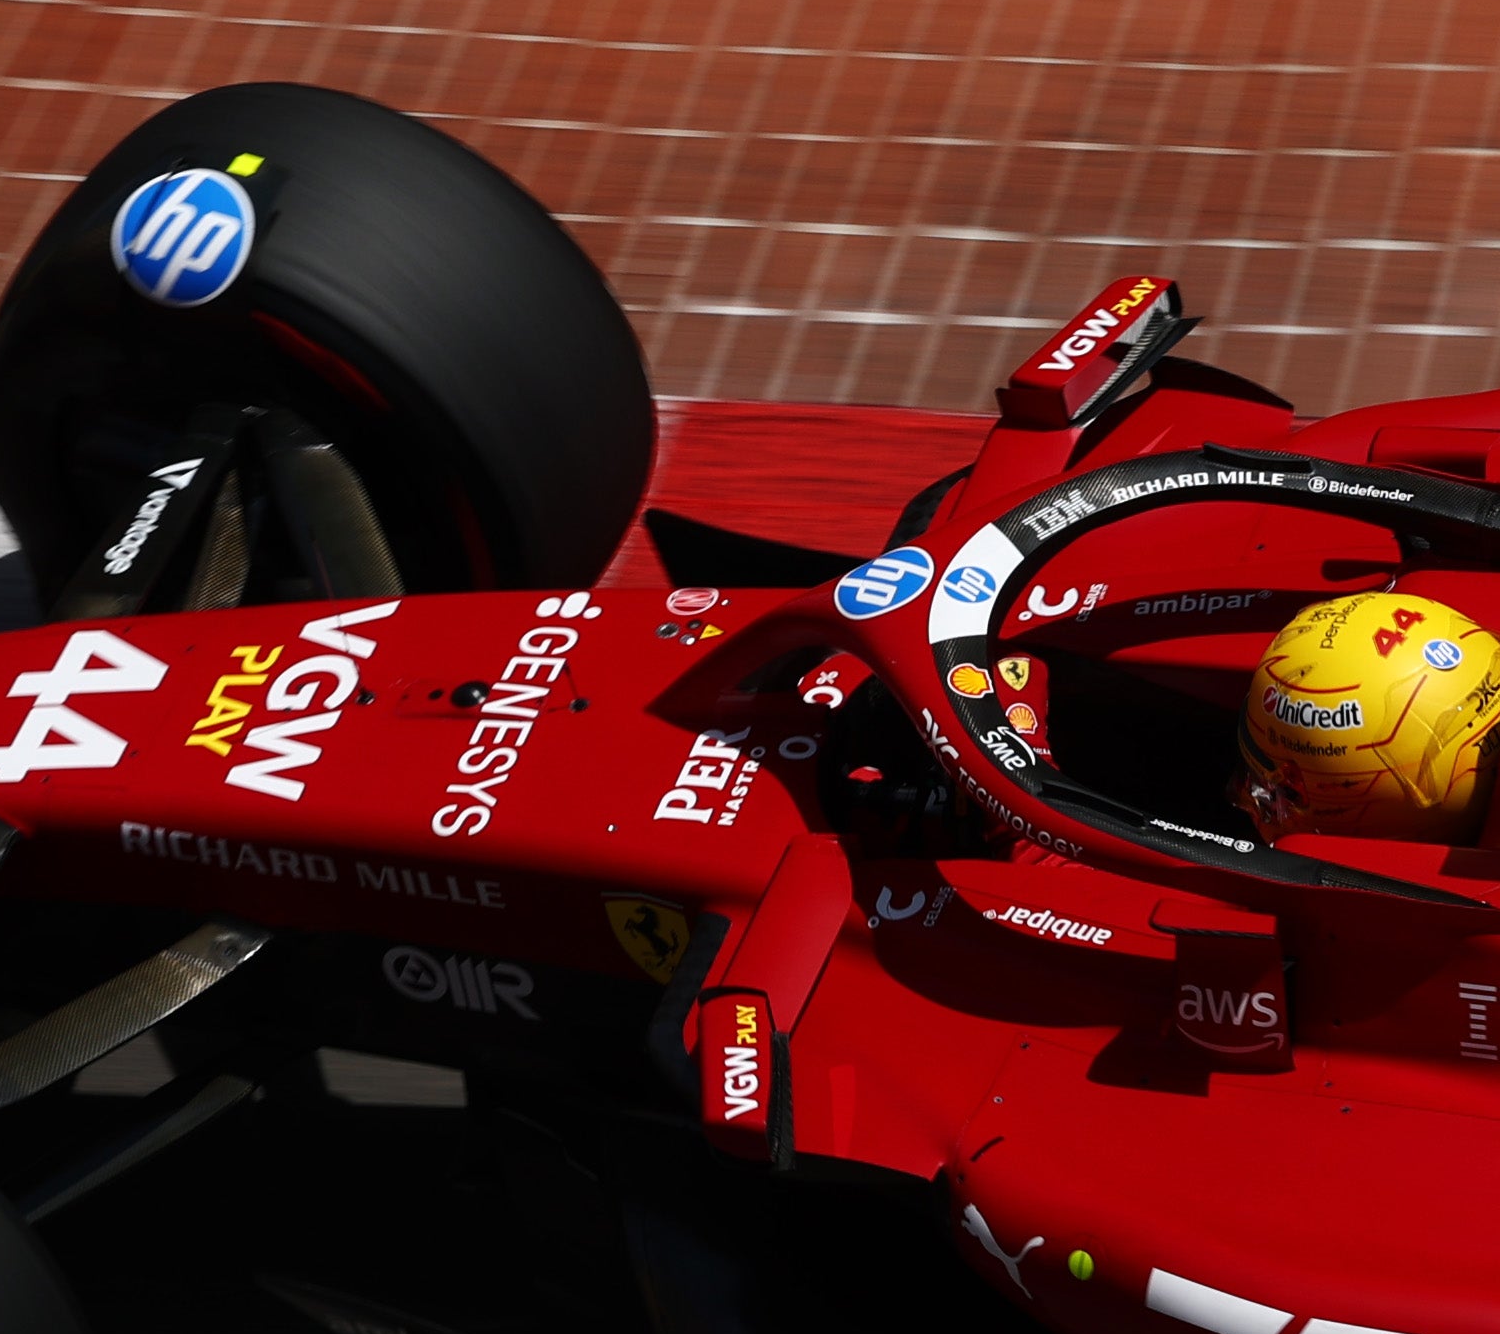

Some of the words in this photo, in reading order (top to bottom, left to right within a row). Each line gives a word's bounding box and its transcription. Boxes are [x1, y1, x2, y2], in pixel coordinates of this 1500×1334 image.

[128, 178, 242, 301] hp
[1038, 308, 1118, 374] VGW
[1117, 277, 1157, 316] PLAY
[1022, 489, 1100, 541] IBM
[1113, 470, 1209, 503] RICHARD
[1216, 470, 1284, 486] MILLE
[1329, 479, 1414, 503] Bitdefender
[1372, 608, 1425, 657] 44
[186, 645, 284, 756] PLAY
[226, 600, 401, 801] VGW
[431, 626, 579, 837] GENESYS
[1275, 695, 1361, 728] UniCredit
[979, 730, 1027, 771] aws
[717, 746, 766, 826] NASTRO
[956, 767, 1084, 858] TECHNOLOGY
[1150, 817, 1234, 849] Bitdefender
[119, 820, 339, 884] RICHARD
[355, 860, 508, 911] MILLE
[737, 1003, 757, 1045] PLAY
[1177, 982, 1279, 1029] aws
[724, 1045, 759, 1121] VGW
